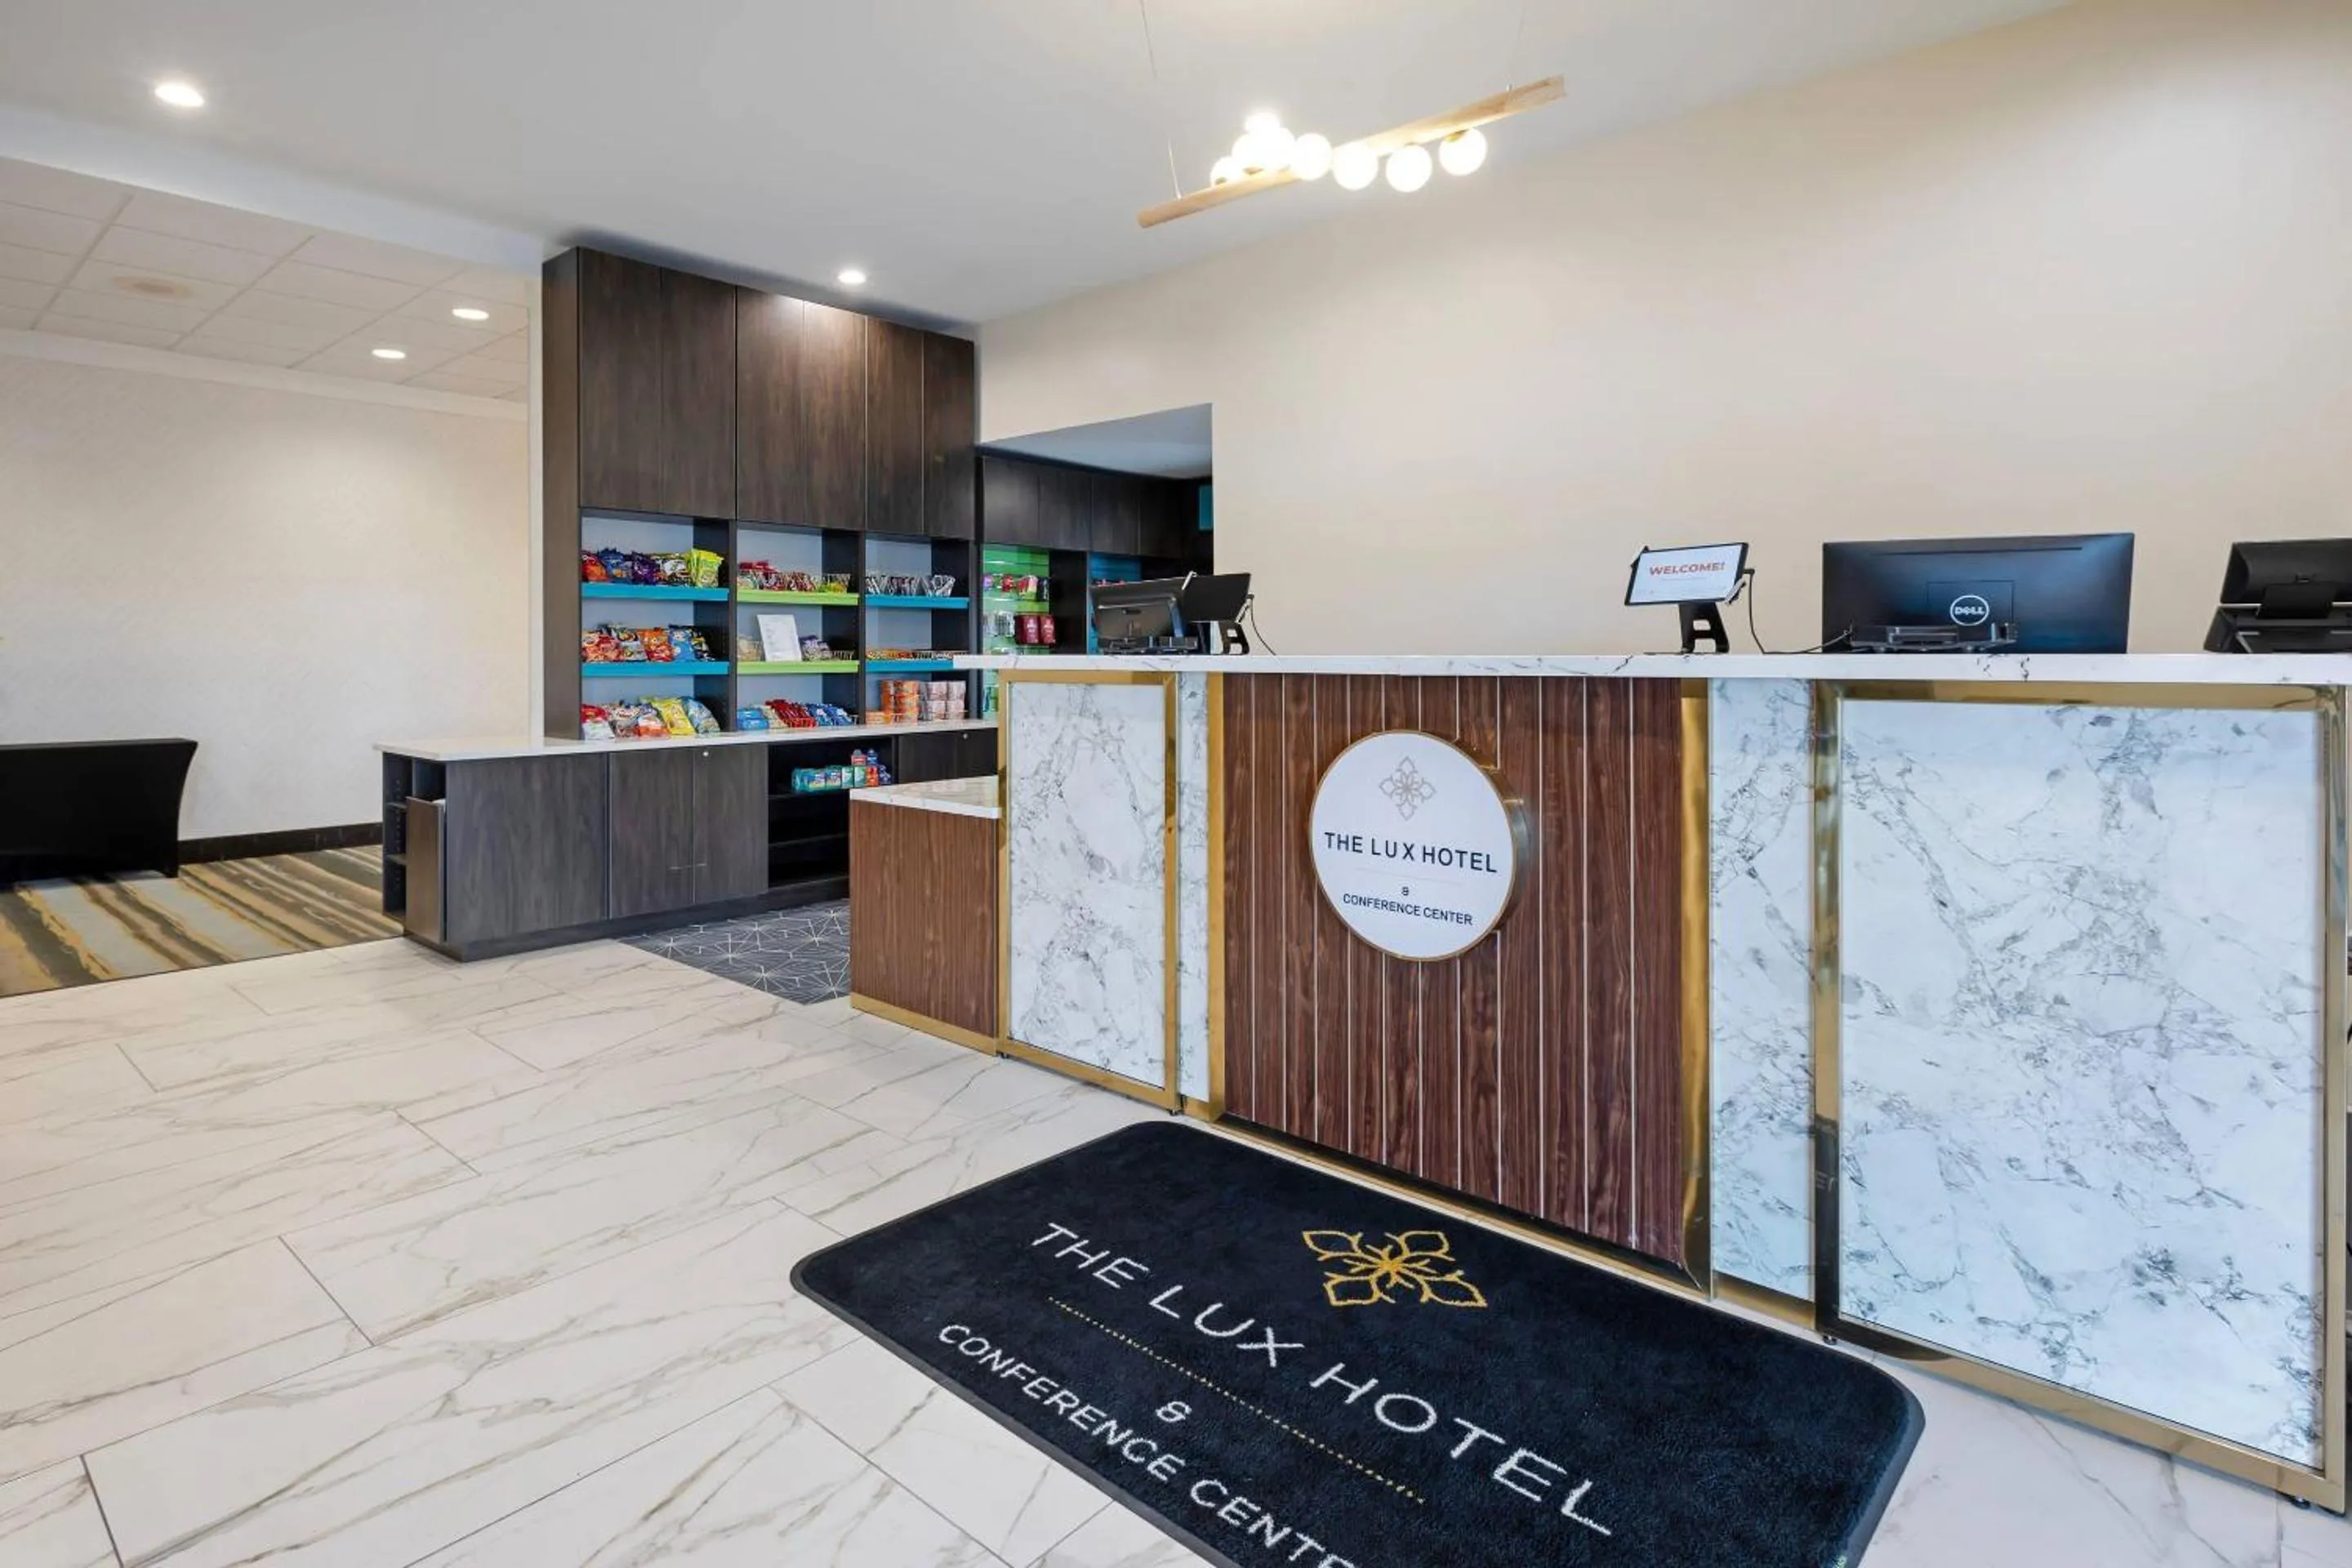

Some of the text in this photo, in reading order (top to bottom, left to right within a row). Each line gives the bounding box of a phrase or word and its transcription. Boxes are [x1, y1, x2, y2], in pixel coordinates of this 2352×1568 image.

[1649, 562, 1726, 576] WELCOME!
[1953, 606, 1984, 615] DELL
[1324, 831, 1498, 873] THE LUX HOTEL
[1343, 893, 1473, 926] CONFERENCE CENTER
[1031, 1223, 1612, 1535] THE LUX HOTEL
[938, 1324, 1186, 1481] CONFERENCE
